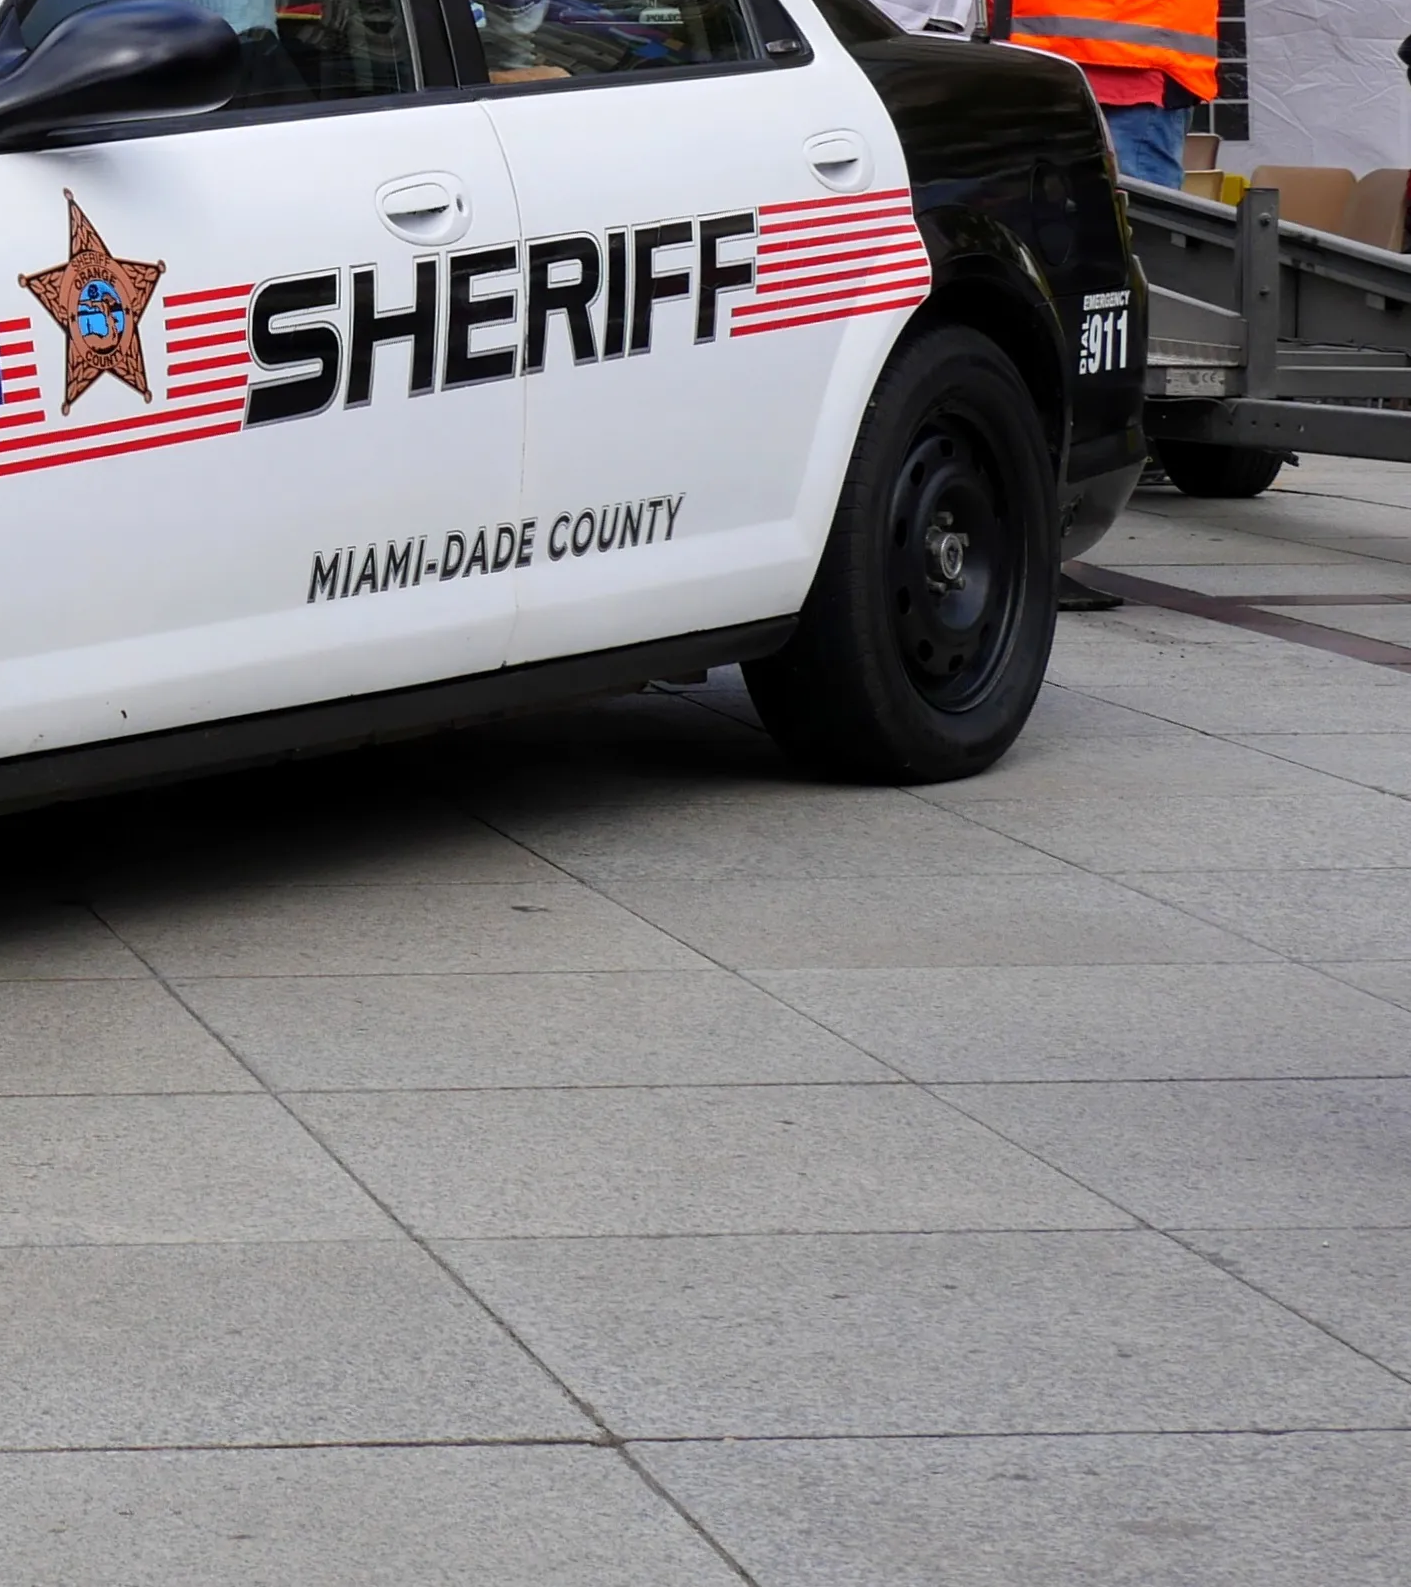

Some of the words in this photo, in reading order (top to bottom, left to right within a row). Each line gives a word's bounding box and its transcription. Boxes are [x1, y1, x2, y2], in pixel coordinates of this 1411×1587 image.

[71, 251, 111, 272] SHERIFF
[74, 267, 118, 291] ORANGE
[1083, 290, 1131, 311] EMERGENCY
[242, 207, 758, 431] SHERIFF
[1088, 310, 1128, 374] 911
[84, 344, 125, 367] COUNTY
[307, 517, 538, 604] MIAMI-DADE
[547, 492, 687, 562] COUNTY
